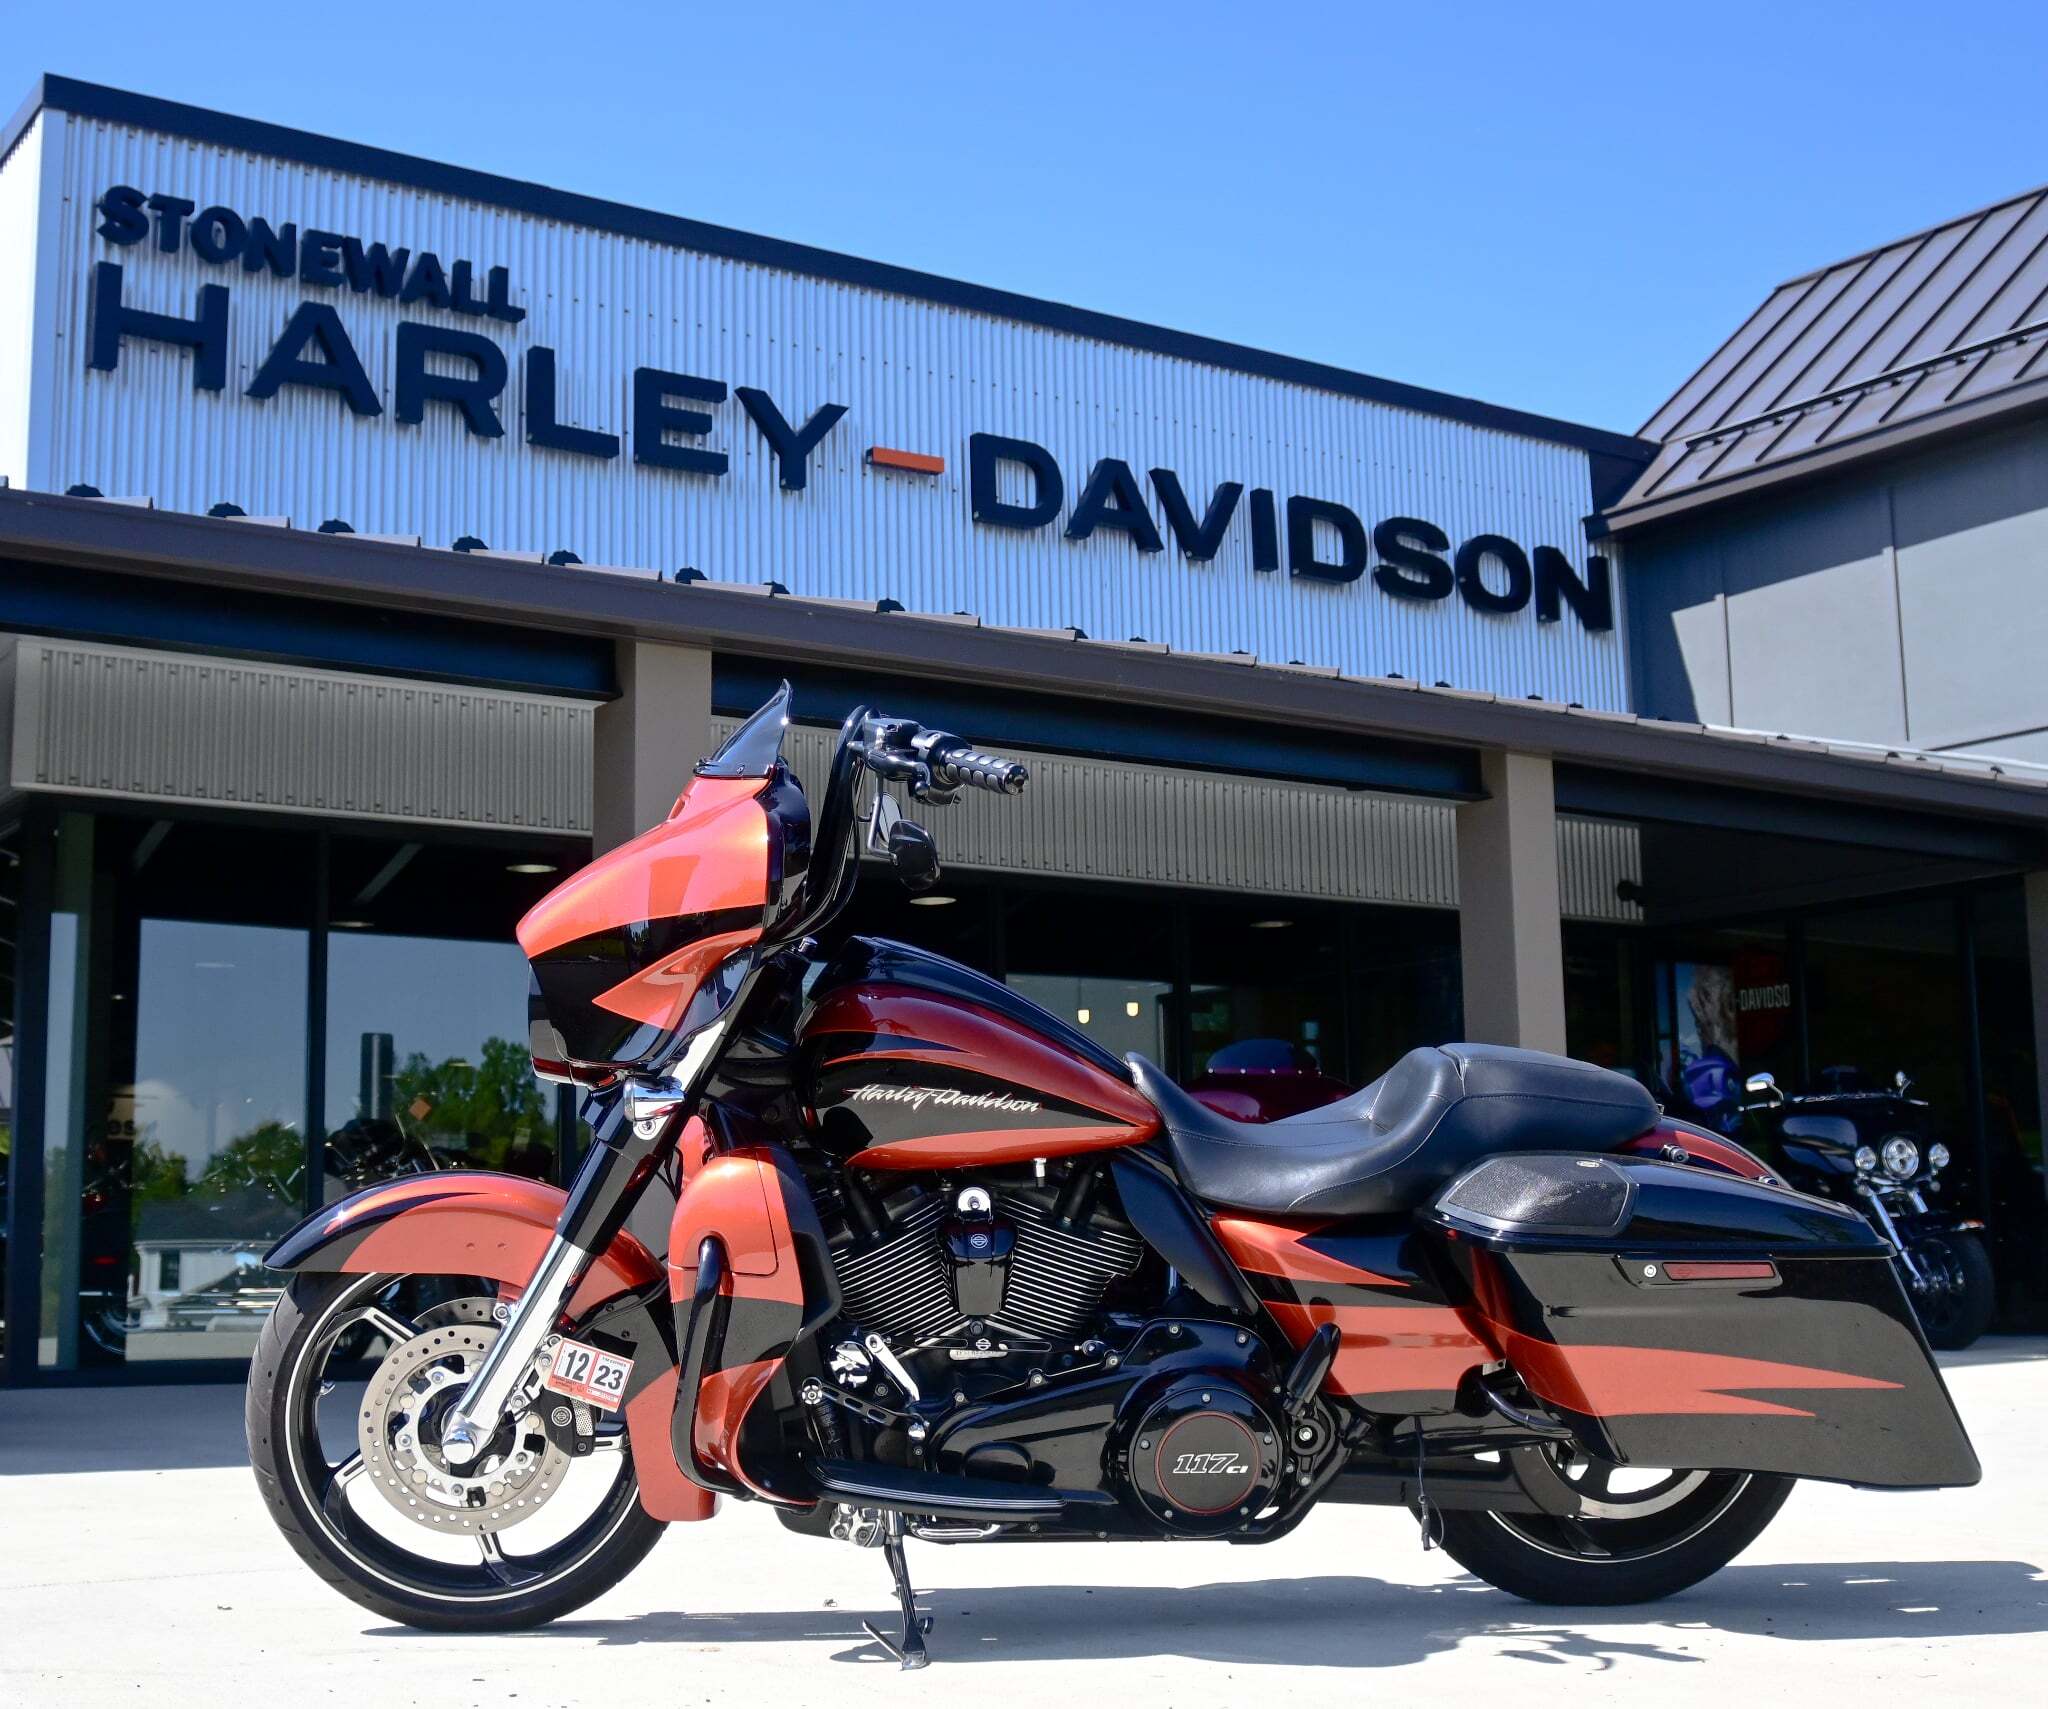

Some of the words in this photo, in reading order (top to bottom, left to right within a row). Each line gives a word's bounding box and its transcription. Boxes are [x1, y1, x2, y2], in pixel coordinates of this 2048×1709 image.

[96, 185, 526, 323] STONEWALL
[564, 1349, 590, 1382] 12
[594, 1364, 624, 1390] 23
